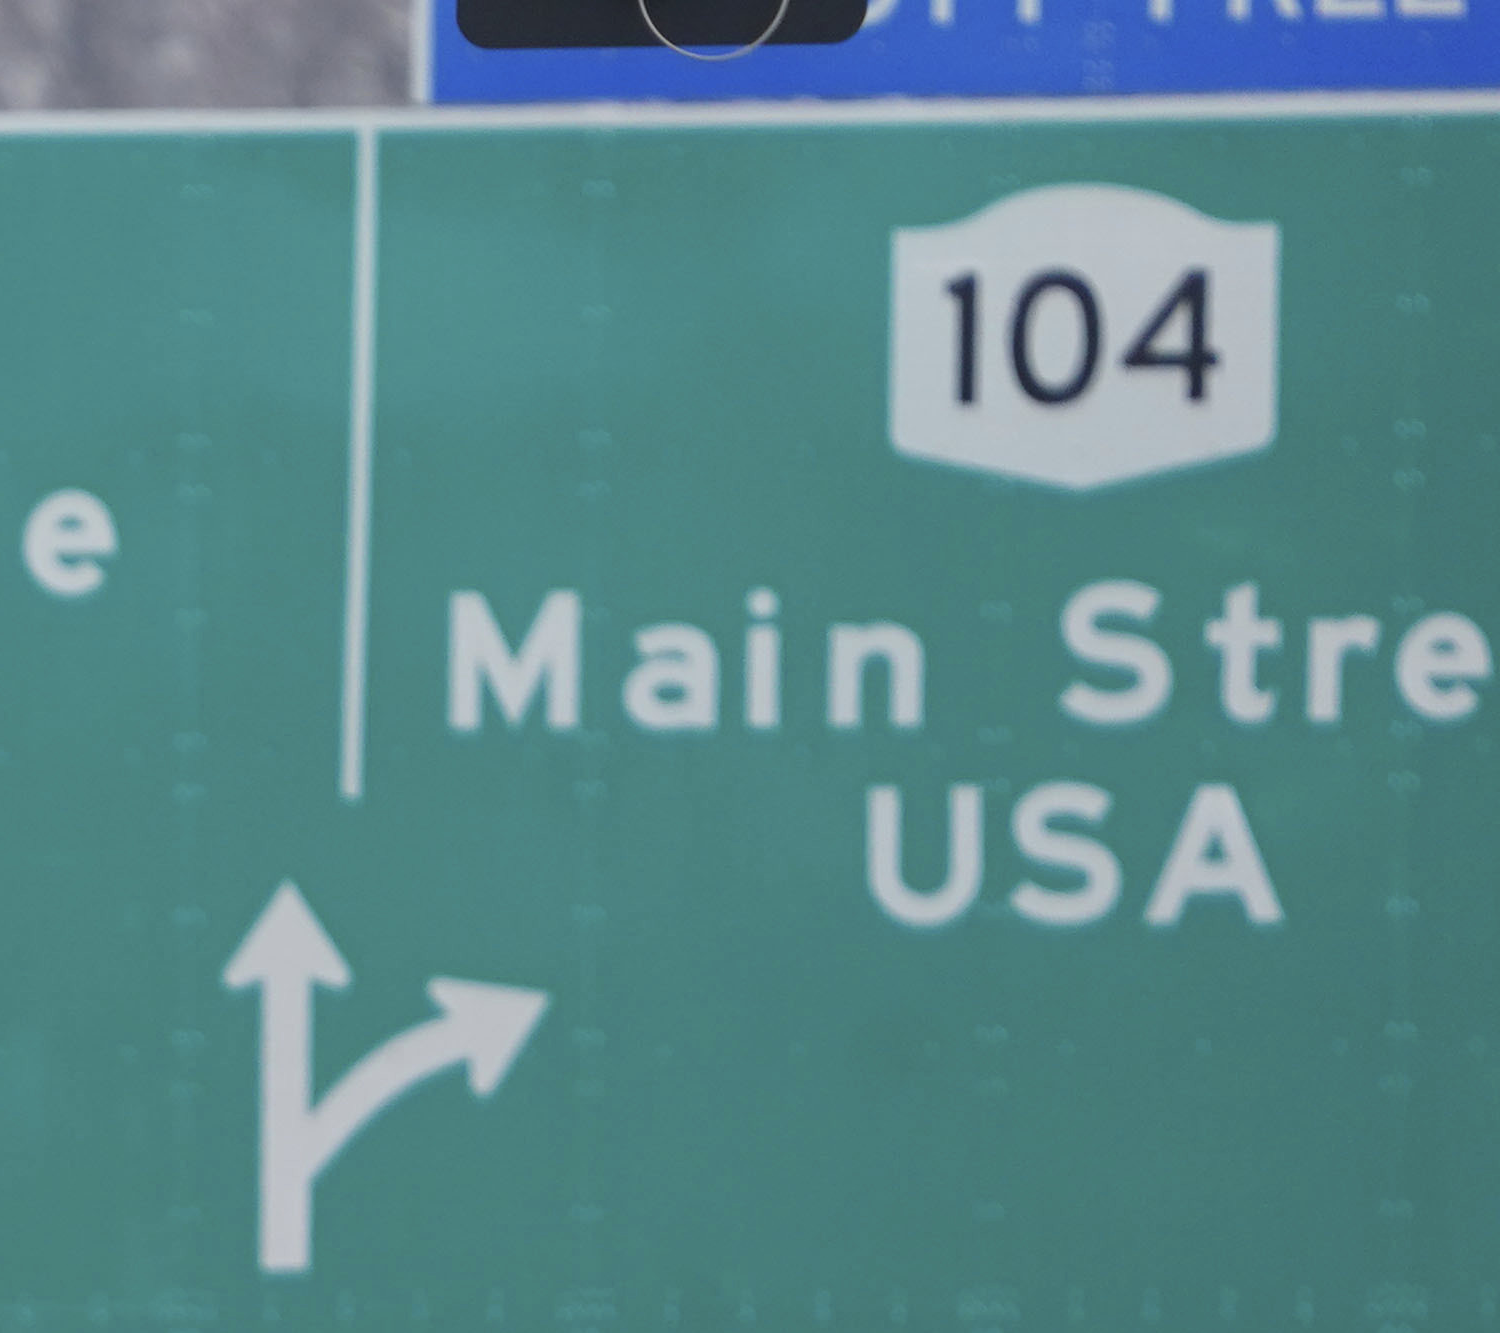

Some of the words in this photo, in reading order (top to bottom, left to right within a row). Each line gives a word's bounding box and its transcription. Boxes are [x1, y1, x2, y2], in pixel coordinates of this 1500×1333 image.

[946, 268, 1220, 407] 104
[447, 588, 924, 732] Main
[1059, 579, 1493, 726] Stre
[866, 781, 1284, 927] USA
